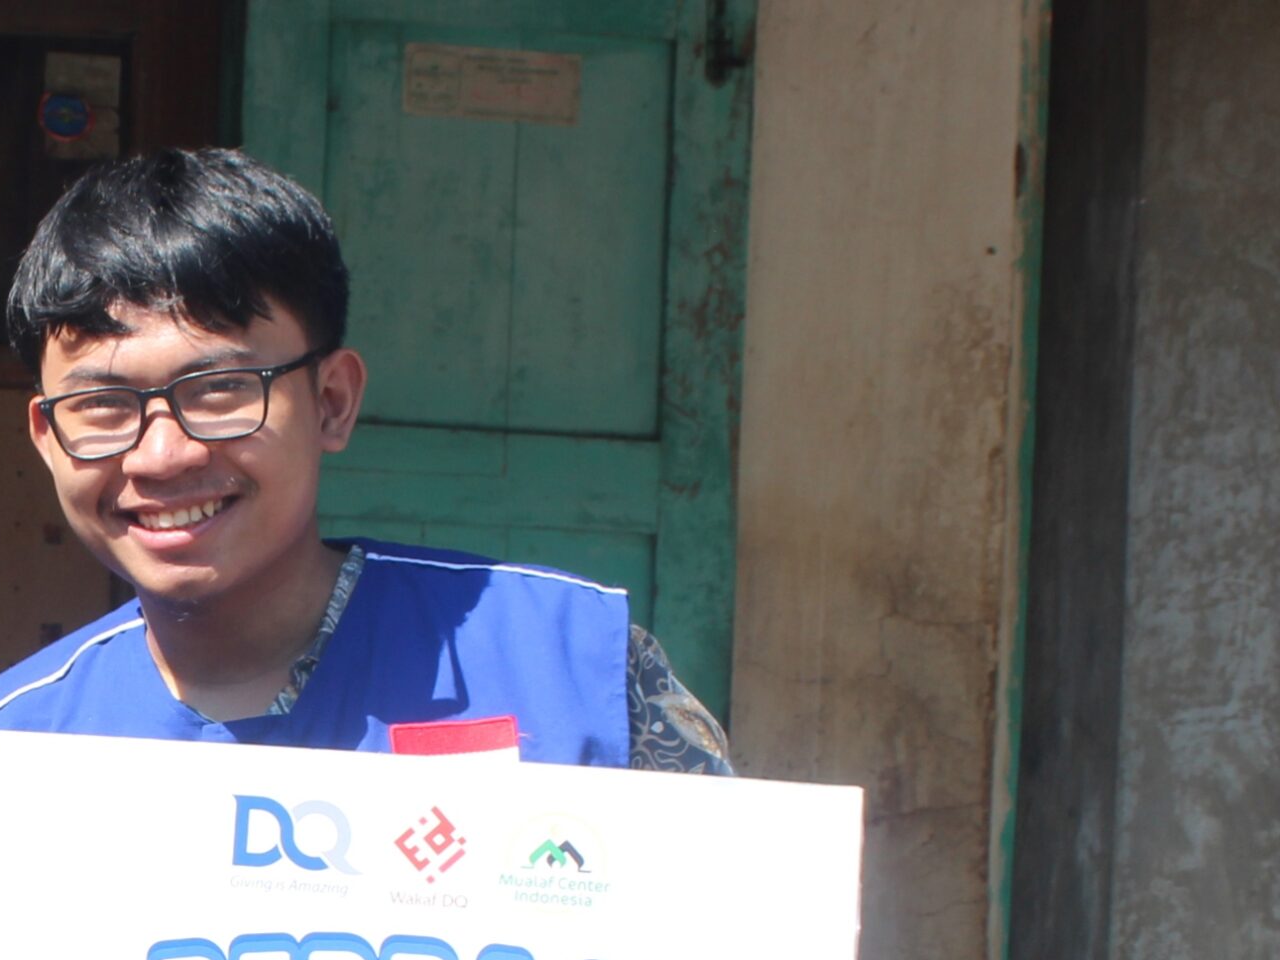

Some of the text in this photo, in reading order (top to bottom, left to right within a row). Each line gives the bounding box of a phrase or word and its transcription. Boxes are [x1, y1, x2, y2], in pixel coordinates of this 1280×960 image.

[230, 875, 272, 893] Giving
[289, 879, 349, 897] Amazing
[498, 873, 612, 893] Mualaf Center
[389, 891, 469, 909] Wakaf DQ
[514, 890, 594, 908] Indonesia
